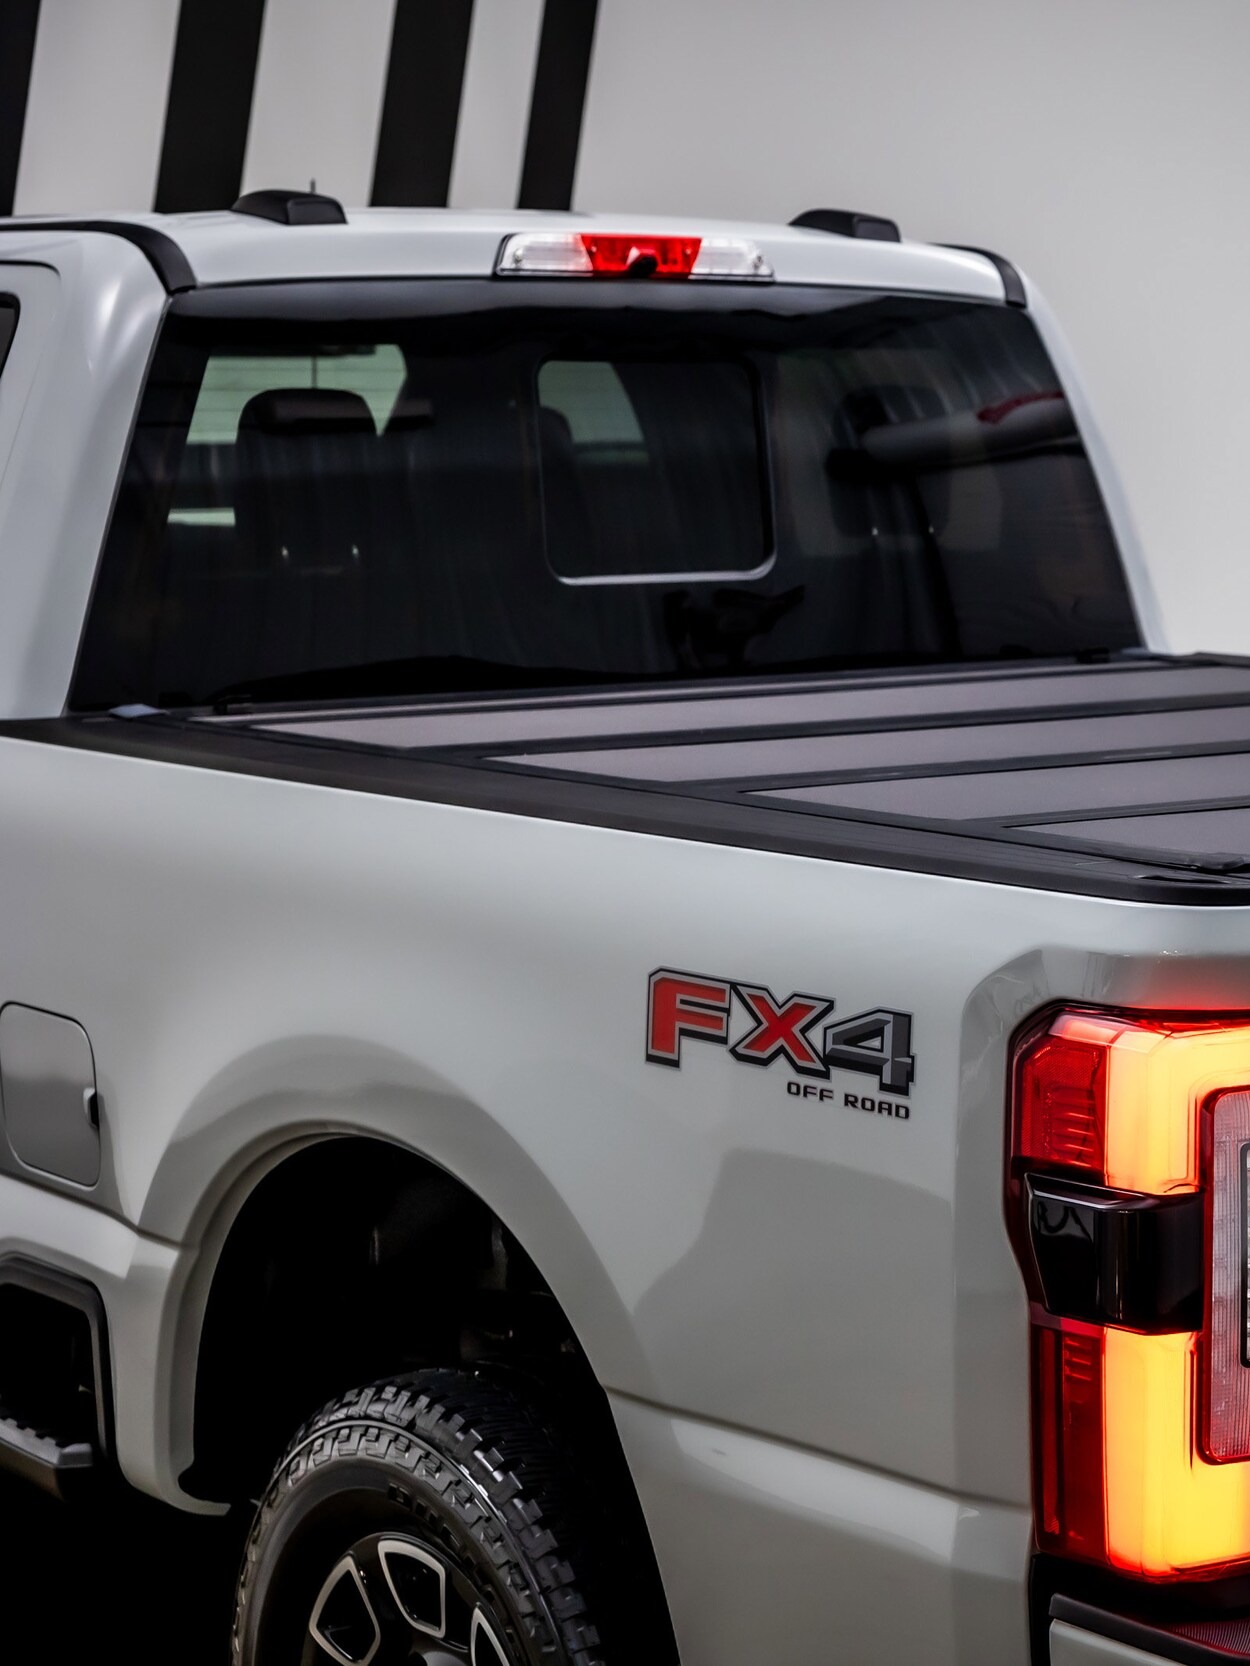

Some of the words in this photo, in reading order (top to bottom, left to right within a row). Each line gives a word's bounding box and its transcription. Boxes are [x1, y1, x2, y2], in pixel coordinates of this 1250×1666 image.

[646, 966, 916, 1096] FX4
[786, 1082, 834, 1102] OFF
[844, 1093, 911, 1120] ROAD
